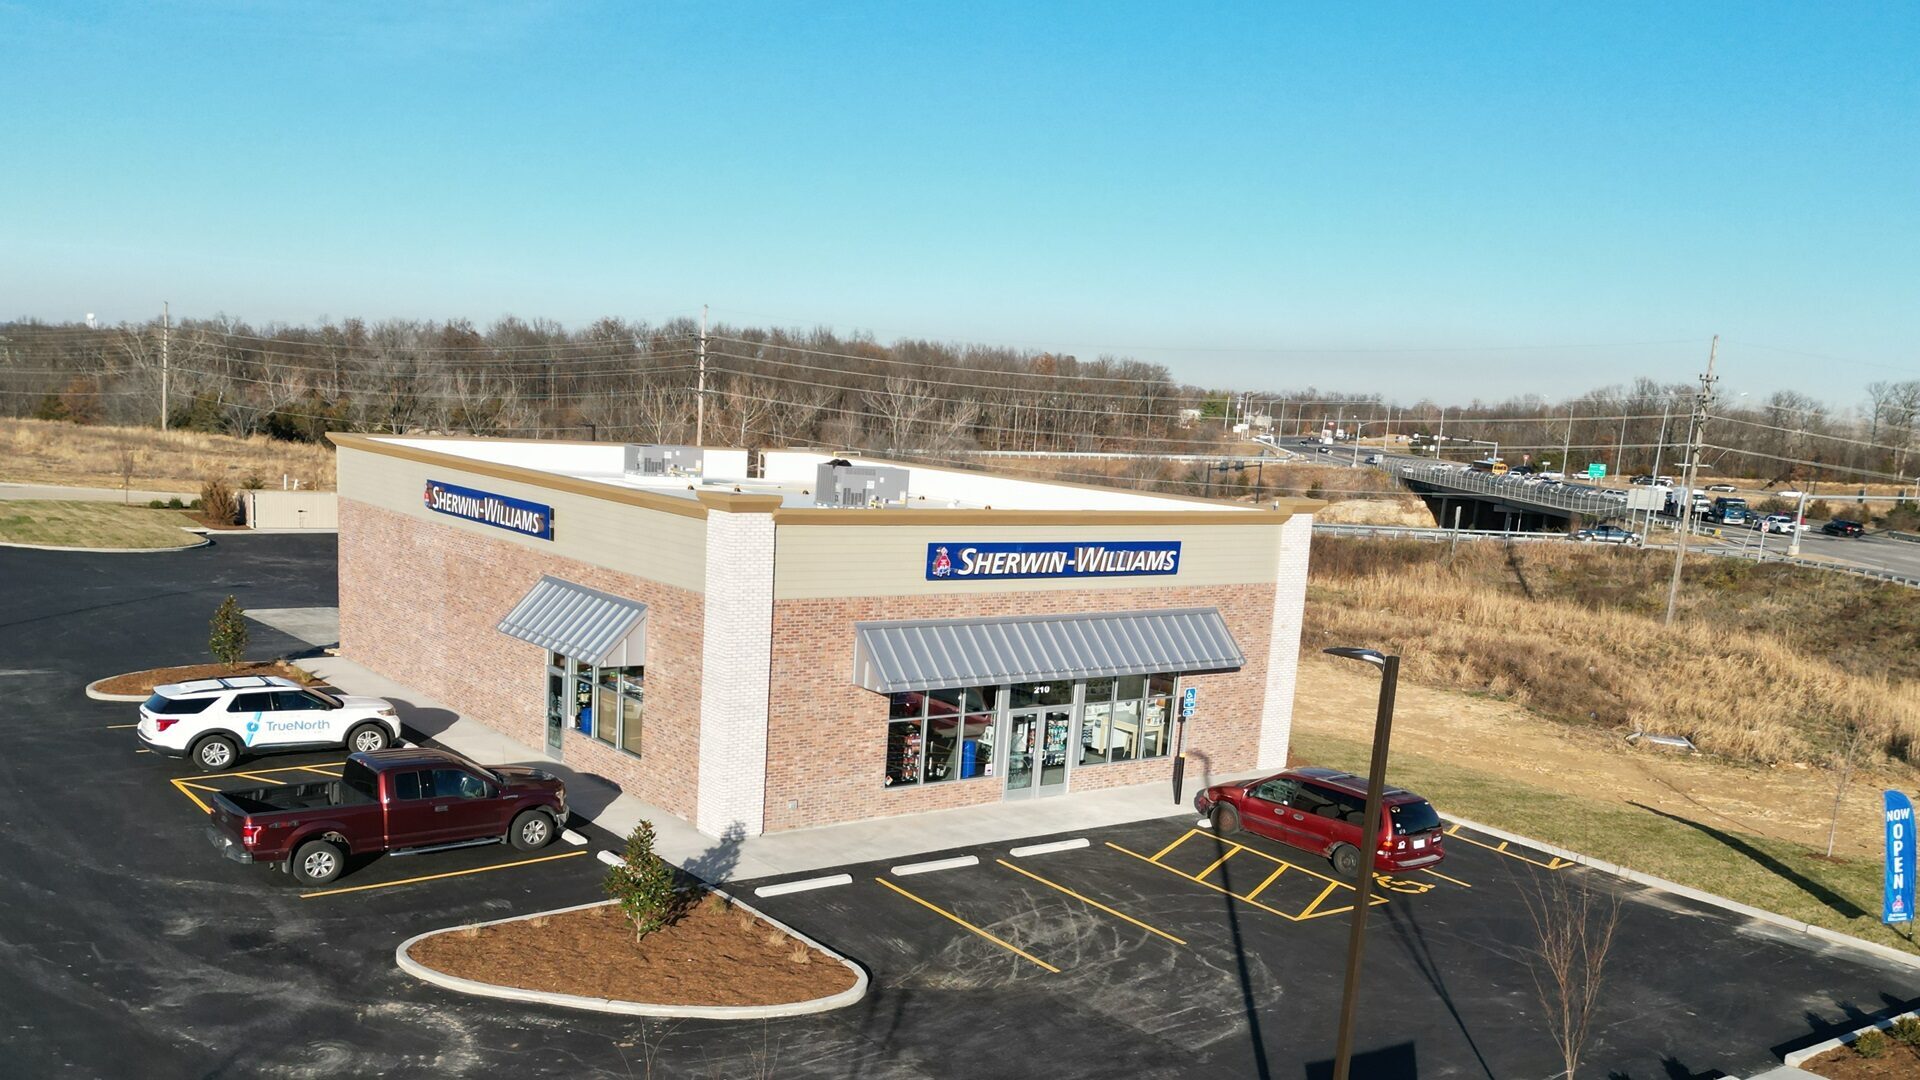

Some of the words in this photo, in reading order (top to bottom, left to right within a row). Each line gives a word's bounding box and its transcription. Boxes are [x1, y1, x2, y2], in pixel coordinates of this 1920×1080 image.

[1034, 686, 1050, 694] 210
[266, 720, 330, 731] TrueNorth
[1887, 808, 1910, 822] NOW
[1893, 823, 1904, 889] OPEN
